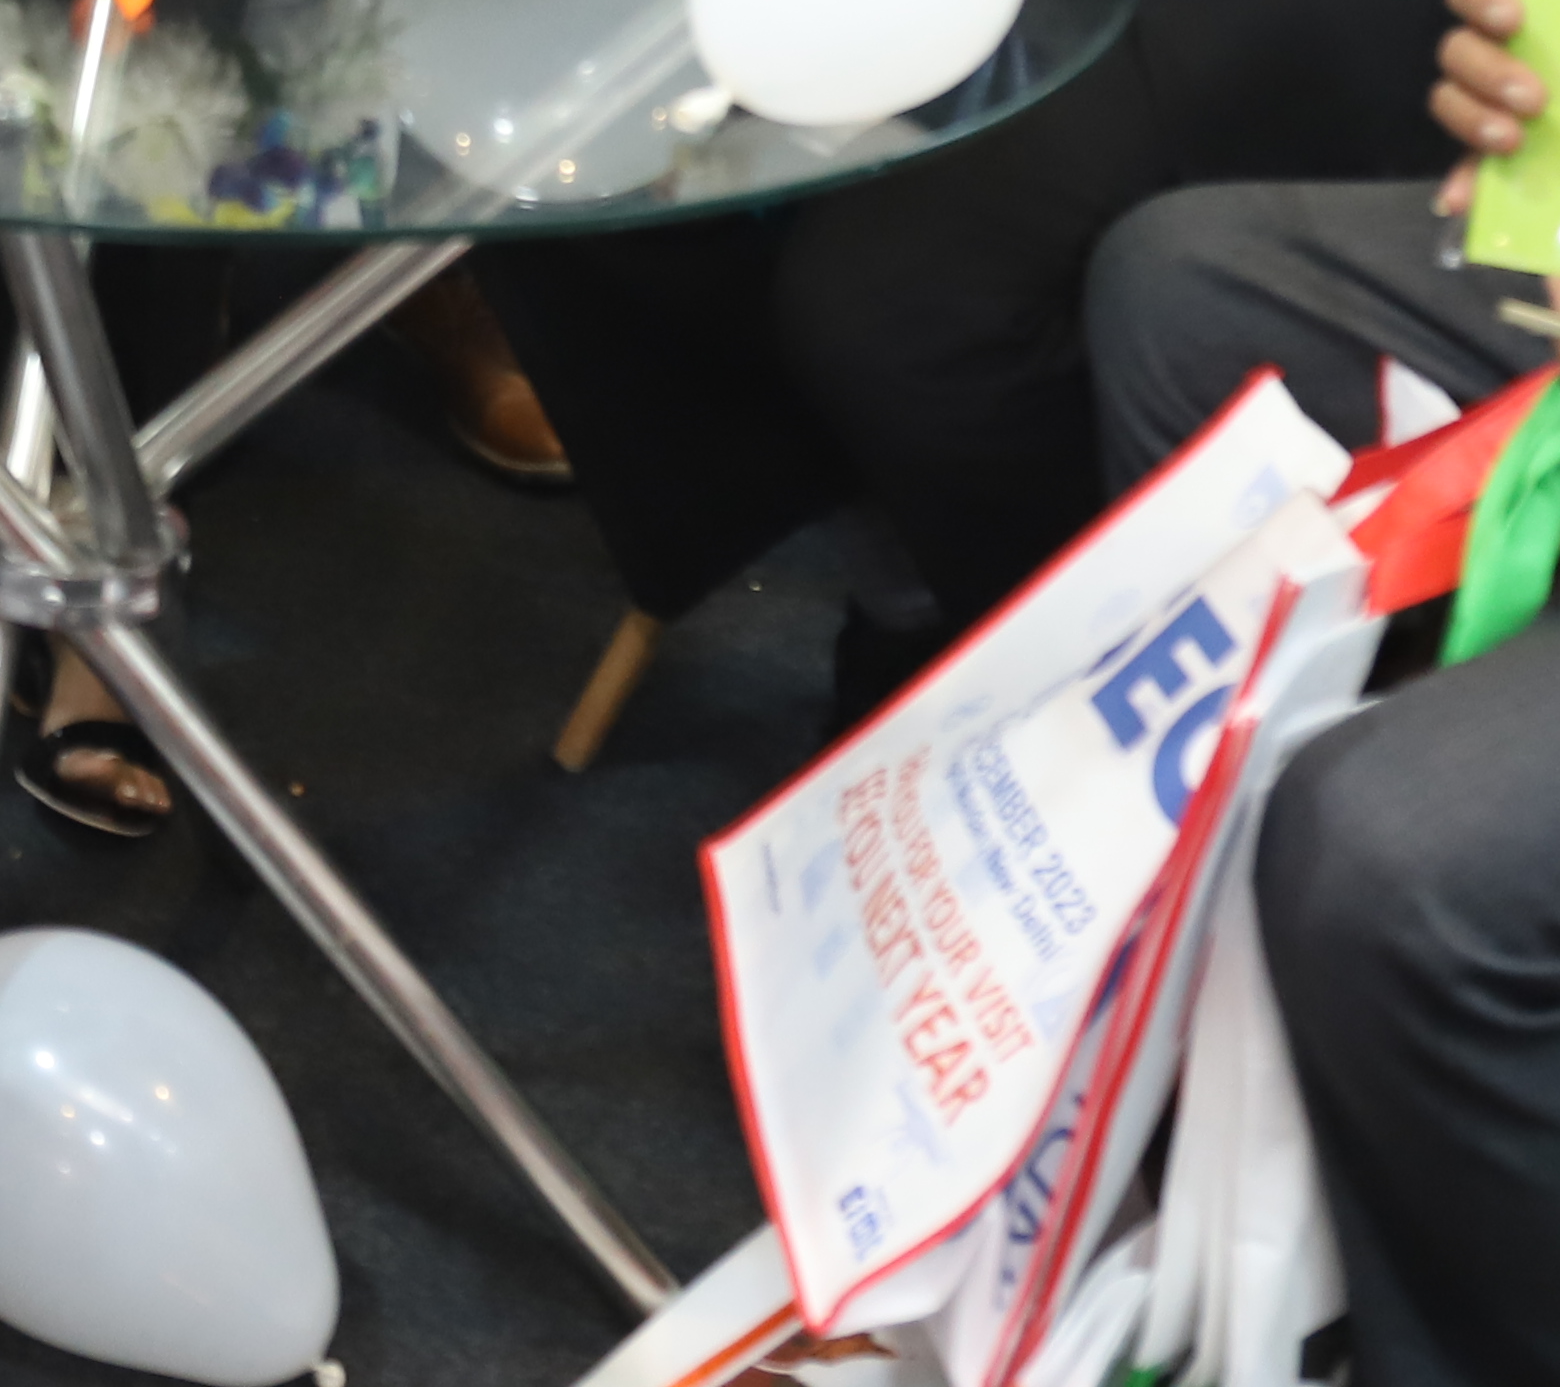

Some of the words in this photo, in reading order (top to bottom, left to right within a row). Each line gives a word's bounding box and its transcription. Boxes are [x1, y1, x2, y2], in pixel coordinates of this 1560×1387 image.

[860, 867, 925, 990] NEXT
[1032, 850, 1099, 936] 2023
[920, 875, 983, 978] YOUR
[963, 964, 1035, 1065] VISIT
[892, 968, 992, 1129] YEAR
